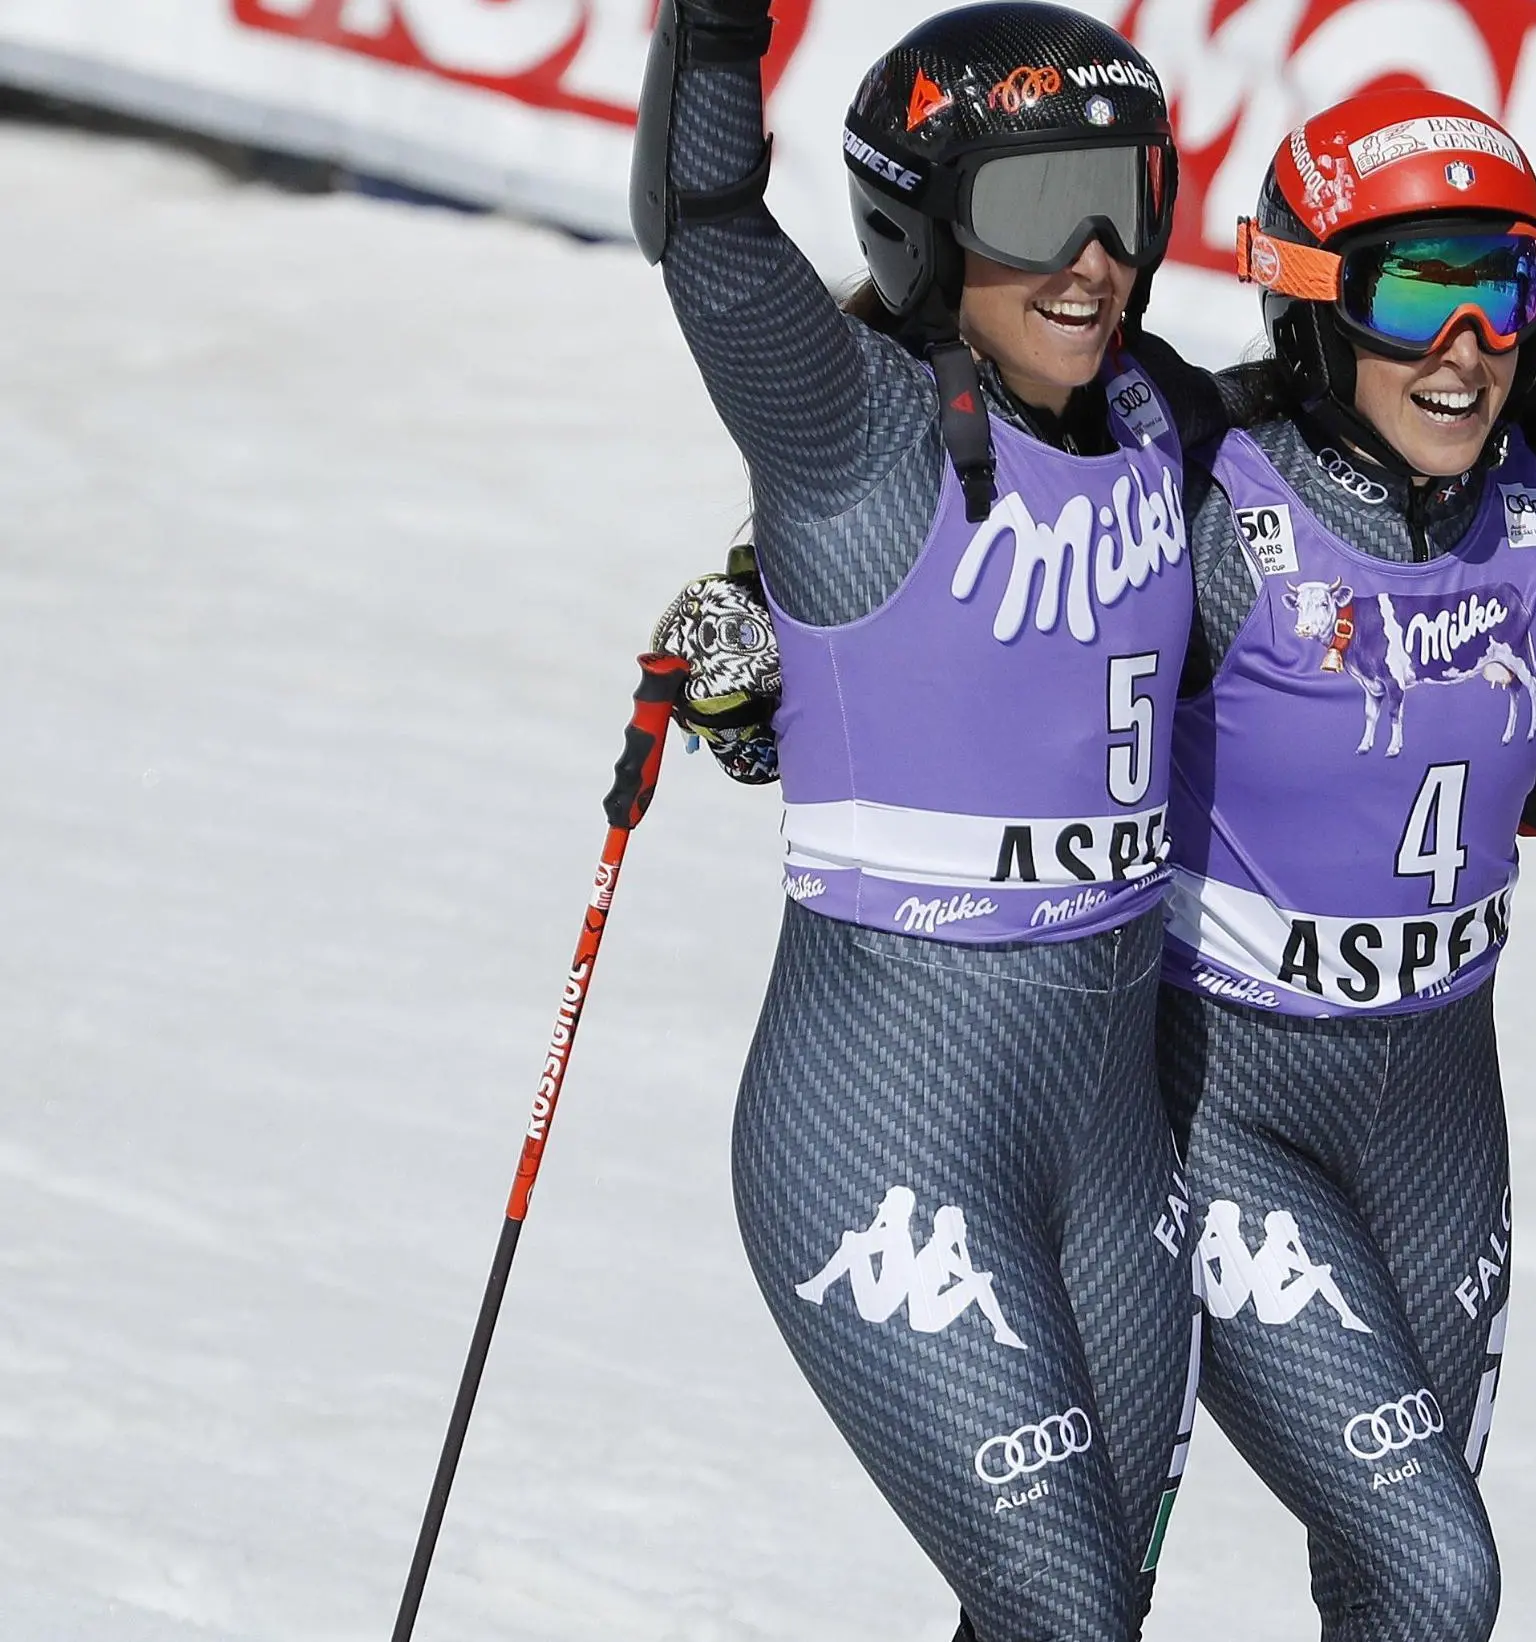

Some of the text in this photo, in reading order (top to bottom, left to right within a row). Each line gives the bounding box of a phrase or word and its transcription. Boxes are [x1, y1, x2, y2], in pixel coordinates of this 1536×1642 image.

[1427, 118, 1497, 140] BANCA
[1236, 509, 1280, 541] 50
[1405, 593, 1508, 666] Milka
[1107, 650, 1159, 806] 5
[1393, 760, 1470, 907] 4
[895, 891, 999, 933] Milka
[526, 962, 588, 1140] ROSSIGNOL
[1371, 1457, 1422, 1490] Audi
[993, 1479, 1050, 1514] Audi
